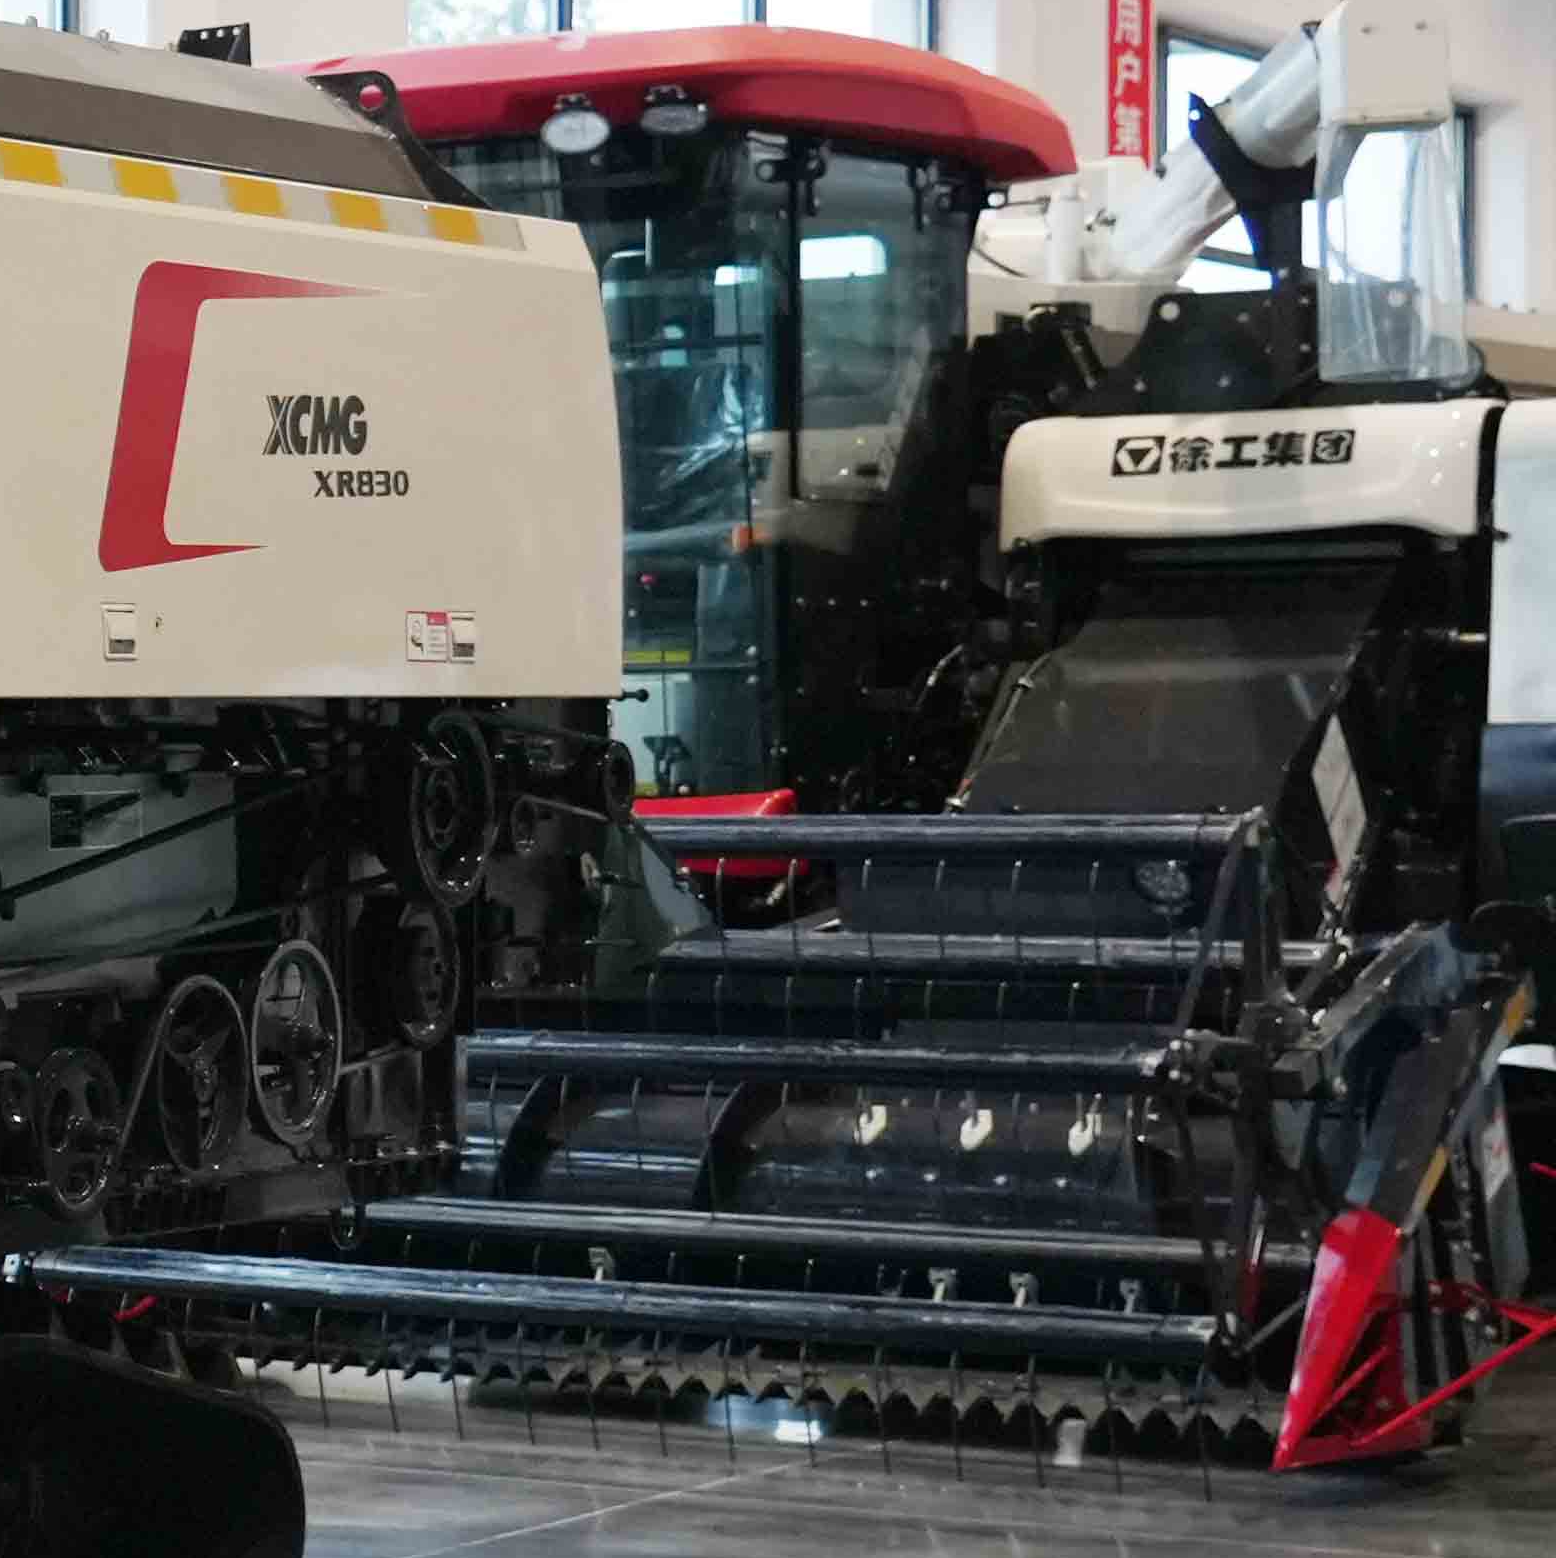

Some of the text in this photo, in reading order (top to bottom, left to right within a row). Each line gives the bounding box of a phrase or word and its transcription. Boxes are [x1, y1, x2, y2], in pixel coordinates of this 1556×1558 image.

[262, 394, 368, 456] XCMG
[1168, 429, 1356, 474] 徐工集团
[312, 469, 410, 499] XR830
